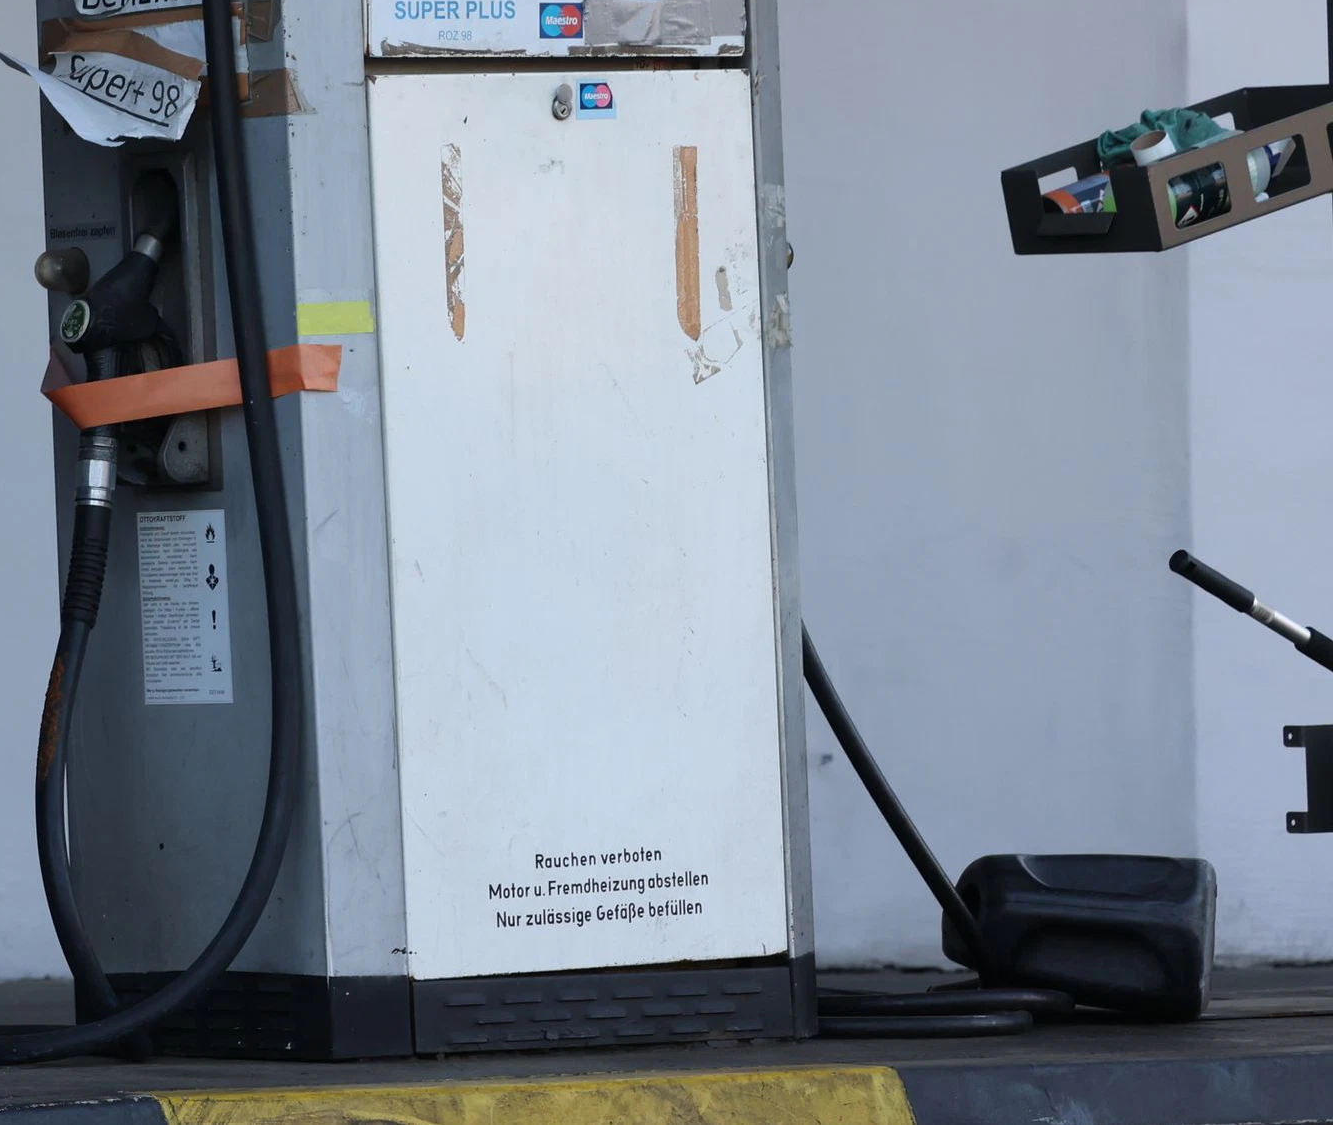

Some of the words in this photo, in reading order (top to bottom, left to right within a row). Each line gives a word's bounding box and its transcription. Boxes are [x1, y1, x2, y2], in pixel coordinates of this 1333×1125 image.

[395, 1, 459, 20] SUPER
[465, 1, 516, 19] PLUS
[545, 15, 578, 27] Maestro
[439, 31, 459, 41] ROZ
[461, 31, 473, 41] 98
[149, 81, 181, 119] 98
[583, 91, 609, 101] Maestro
[89, 225, 116, 239] zapfen
[535, 852, 597, 869] Rauchen
[601, 847, 662, 866] verboten
[489, 883, 531, 899] Motor
[534, 885, 545, 897] u.
[548, 877, 645, 895] Fremdheizung
[647, 871, 709, 889] abstellen
[496, 911, 521, 927] Nur
[526, 907, 592, 927] zulässige
[597, 903, 645, 923] Gefäße
[649, 899, 703, 917] befüllen
